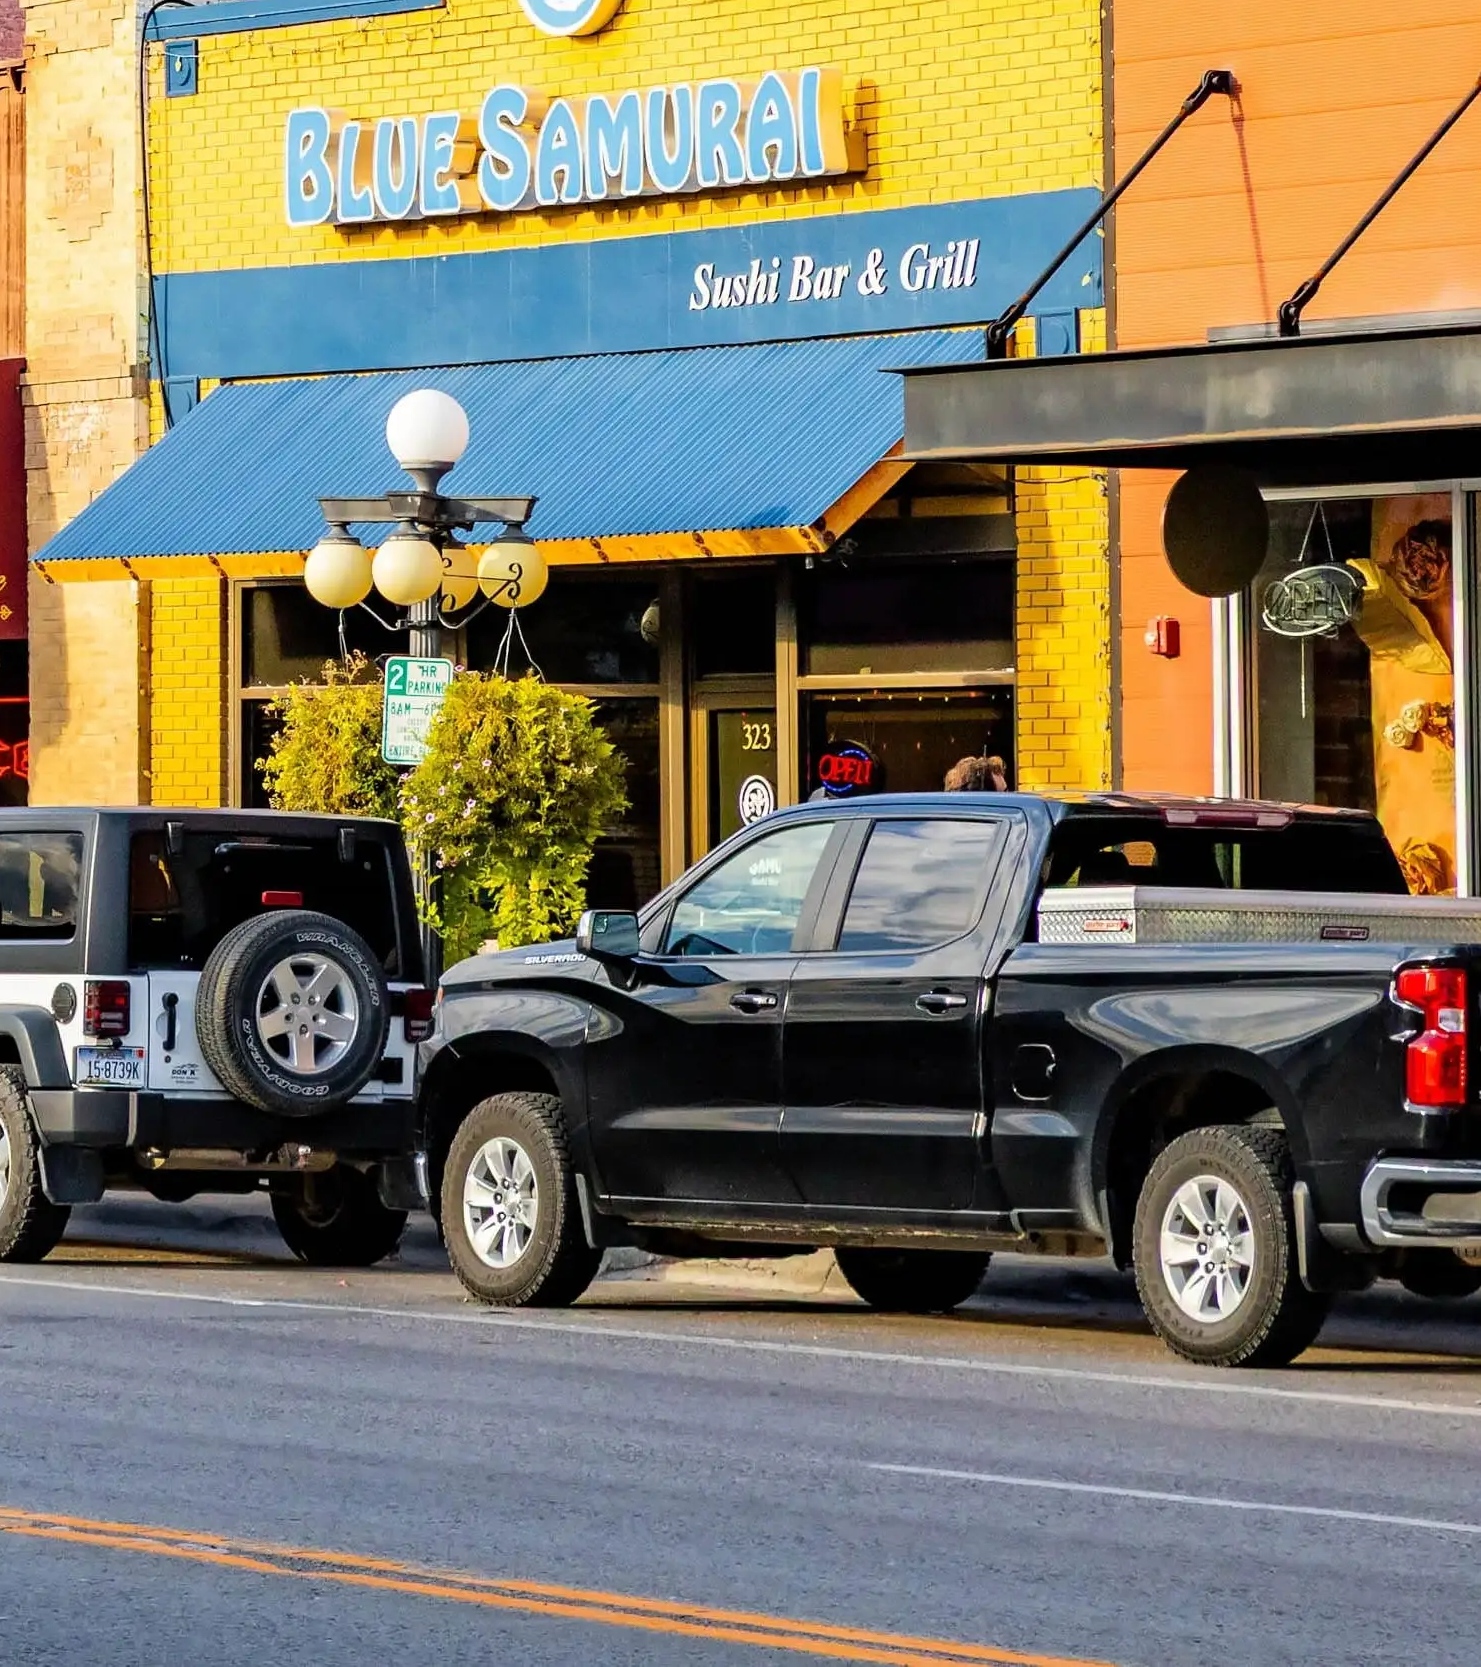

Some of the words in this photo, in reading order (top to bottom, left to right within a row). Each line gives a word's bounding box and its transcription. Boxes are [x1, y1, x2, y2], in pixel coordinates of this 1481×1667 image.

[284, 106, 459, 227] BLUE
[477, 67, 825, 212] SAMURAI
[689, 257, 781, 311] Sushi
[787, 255, 851, 302] Bar
[857, 247, 888, 296] &
[899, 238, 980, 293] Grill
[389, 664, 404, 690] 2
[421, 665, 438, 678] HR
[742, 723, 771, 750] 323
[819, 753, 873, 785] OPEN
[296, 932, 380, 1007] WRANGLER
[524, 953, 586, 965] SILVERADO
